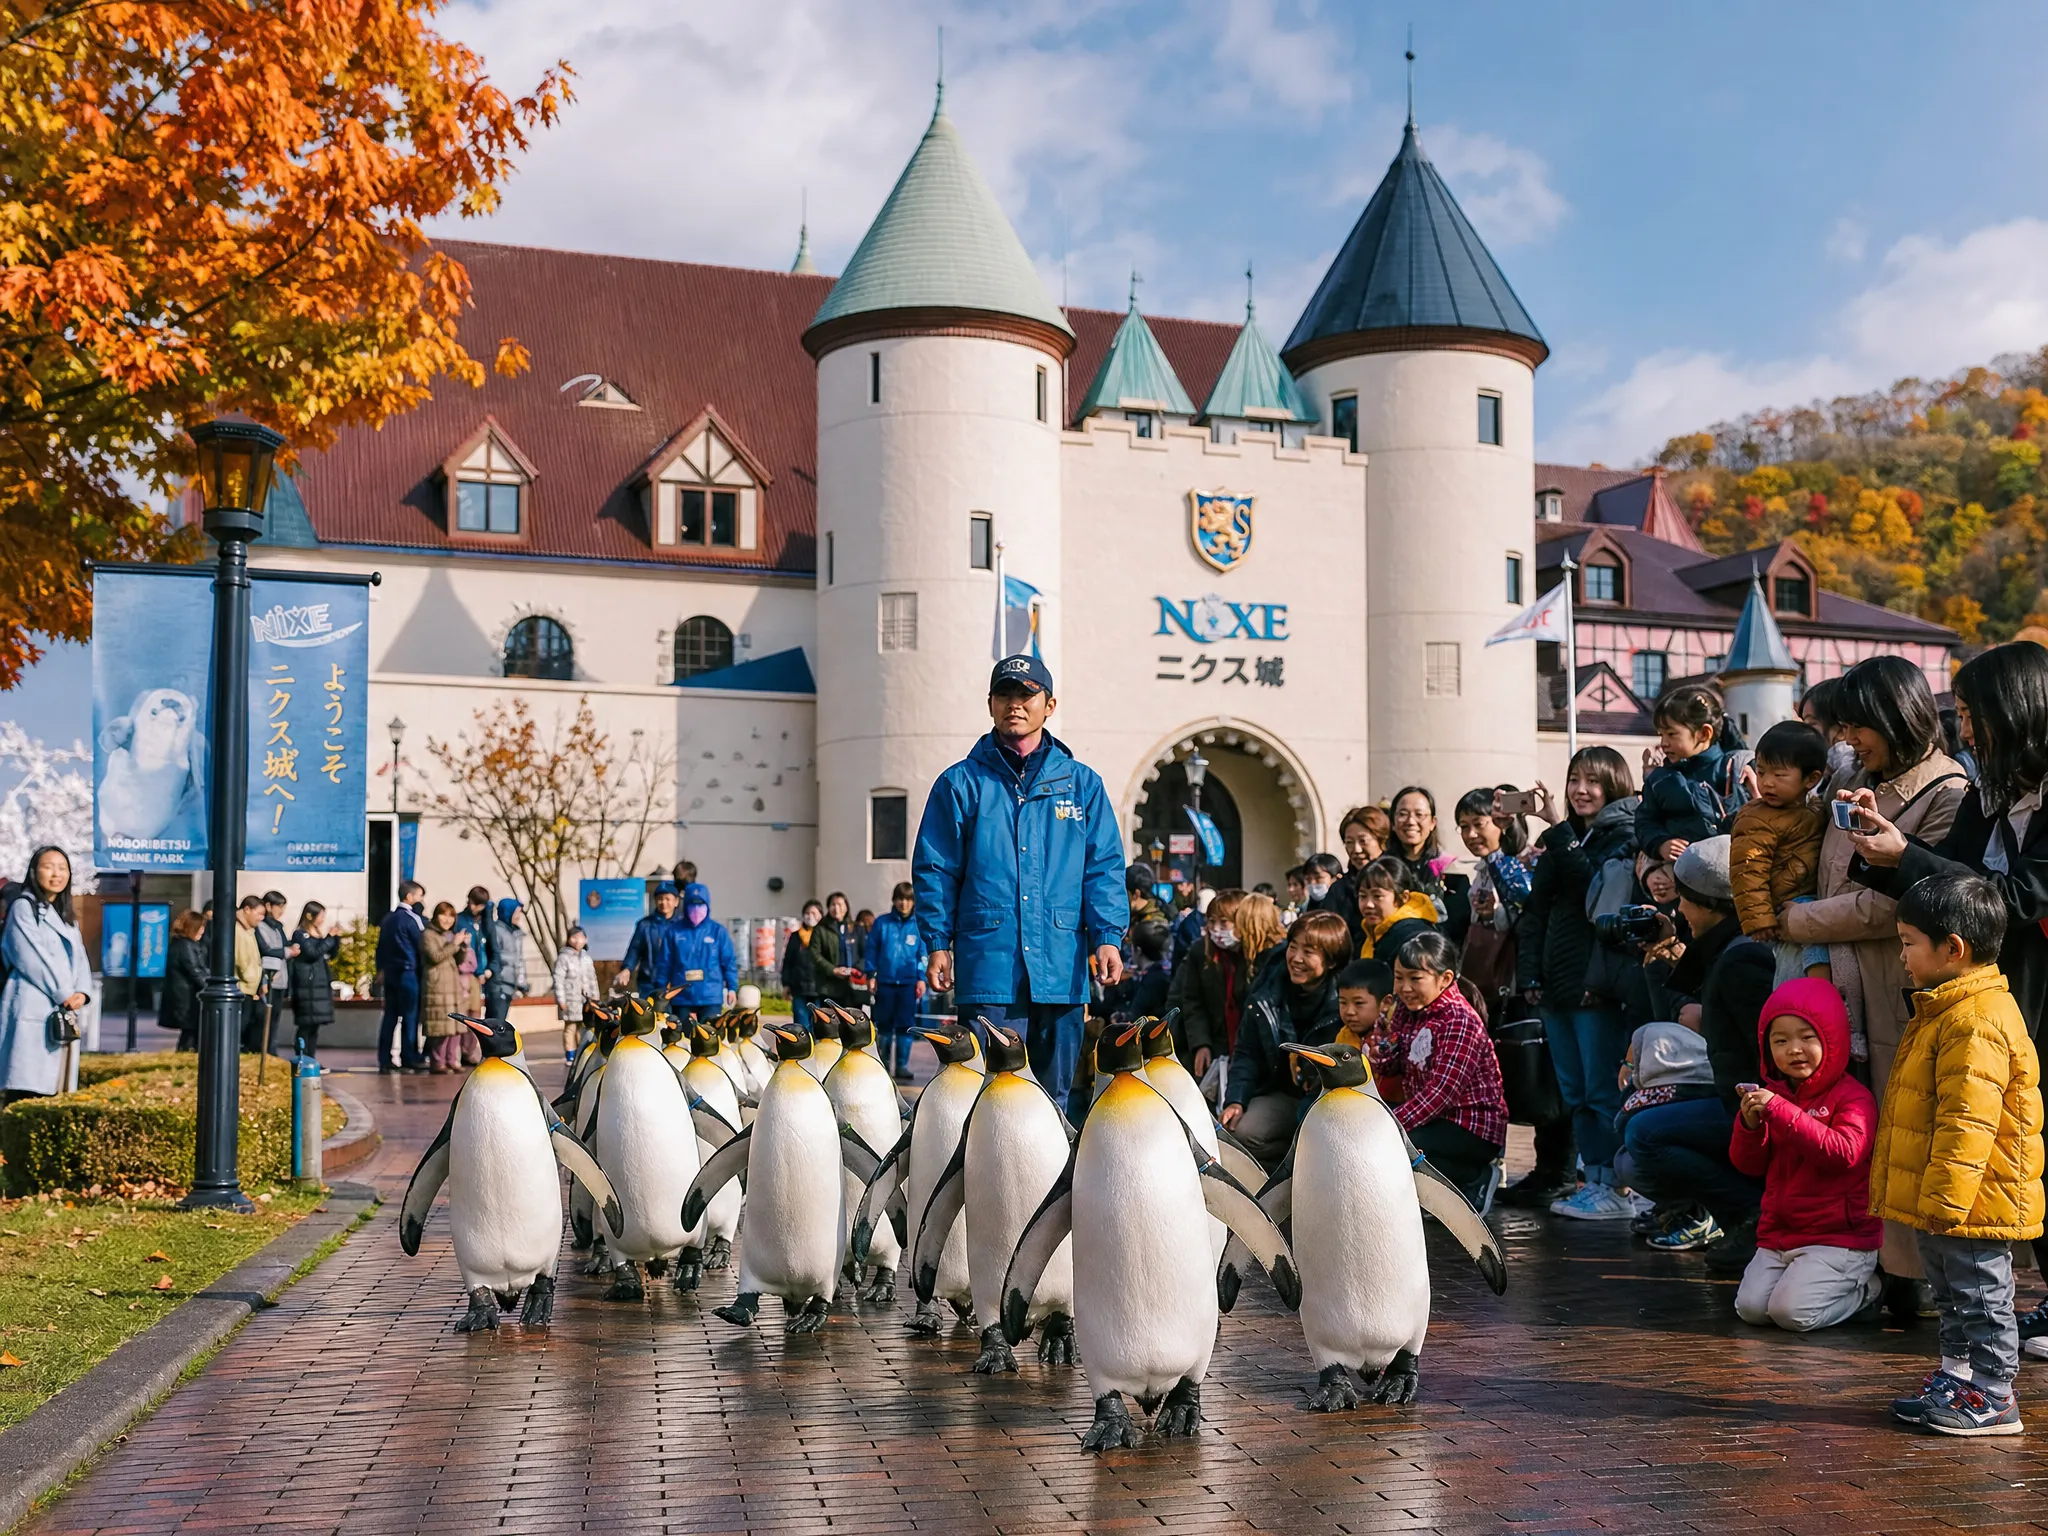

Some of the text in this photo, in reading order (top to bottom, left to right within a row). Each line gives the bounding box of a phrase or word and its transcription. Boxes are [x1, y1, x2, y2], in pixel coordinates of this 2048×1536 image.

[1153, 595, 1290, 643] NXE
[320, 663, 347, 784] ようこそ
[107, 837, 191, 850] NOBORIBETSU
[153, 853, 184, 864] PARK
